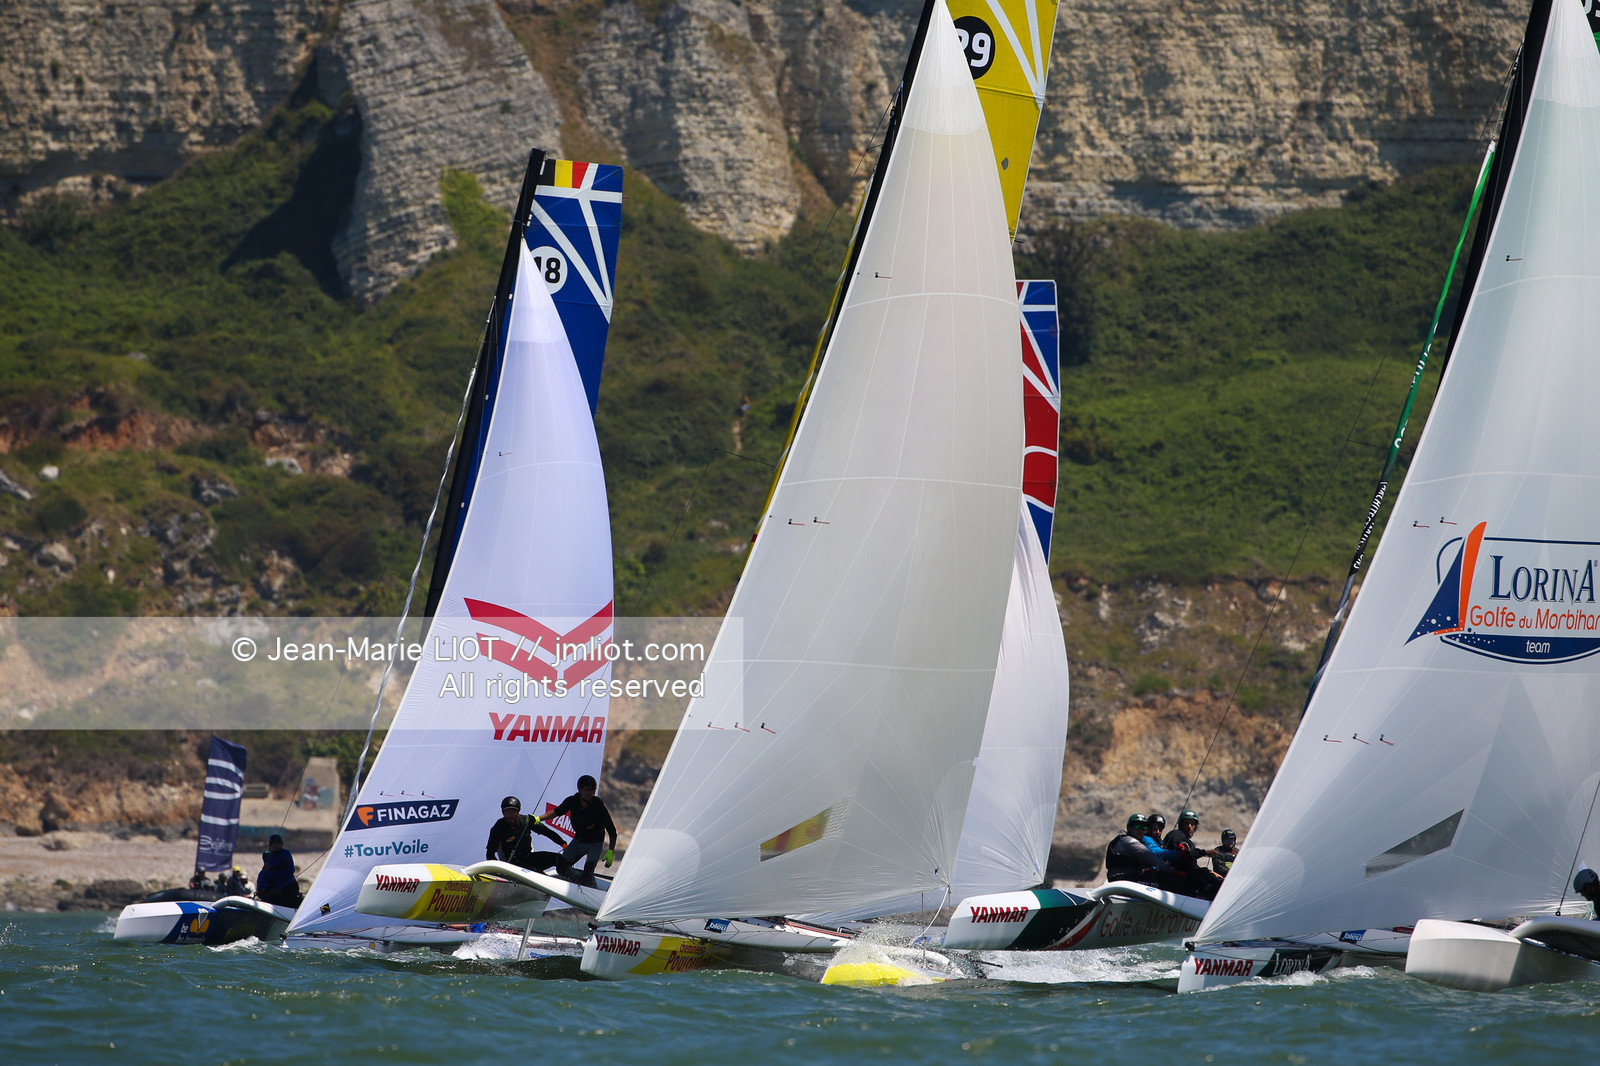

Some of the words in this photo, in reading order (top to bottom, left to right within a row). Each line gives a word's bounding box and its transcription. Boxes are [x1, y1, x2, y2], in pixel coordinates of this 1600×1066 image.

[1470, 605, 1516, 628] Golfe
[1518, 615, 1533, 629] du
[1525, 639, 1551, 654] team
[488, 712, 606, 744] YANMAR
[376, 804, 451, 822] FINAGAZ
[344, 839, 429, 858] #TourVoile
[375, 874, 421, 894] YANMAR
[970, 906, 1029, 924] YANMAR
[1101, 909, 1133, 938] Golfe
[594, 934, 641, 957] YANMAR
[1194, 957, 1254, 977] YANMAR
